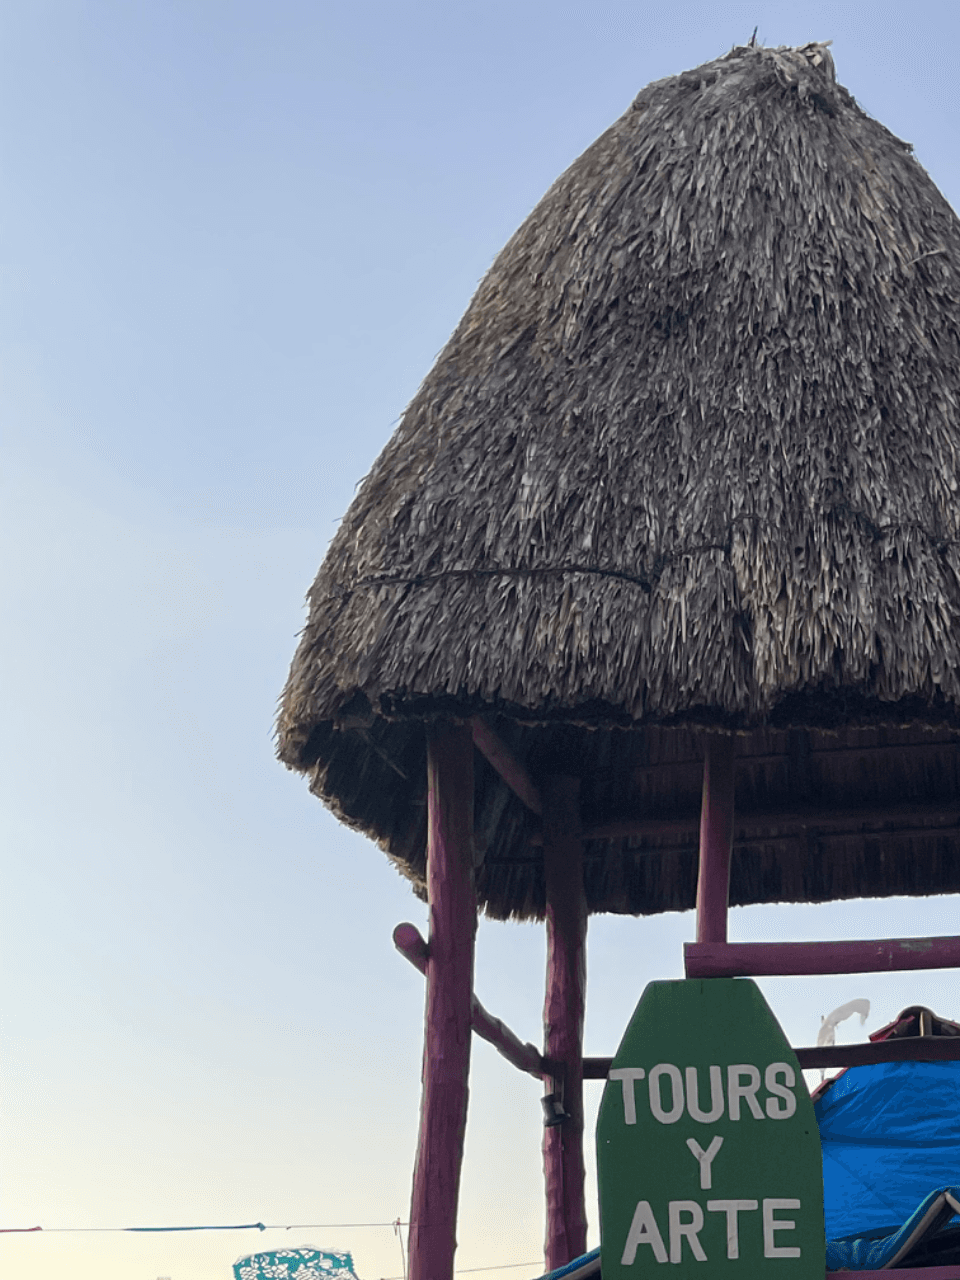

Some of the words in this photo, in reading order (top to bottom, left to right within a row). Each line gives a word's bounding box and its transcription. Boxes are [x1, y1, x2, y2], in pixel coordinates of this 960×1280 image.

[609, 1062, 796, 1125] TOURS
[686, 1135, 724, 1190] Y
[620, 1198, 801, 1265] ARTE
